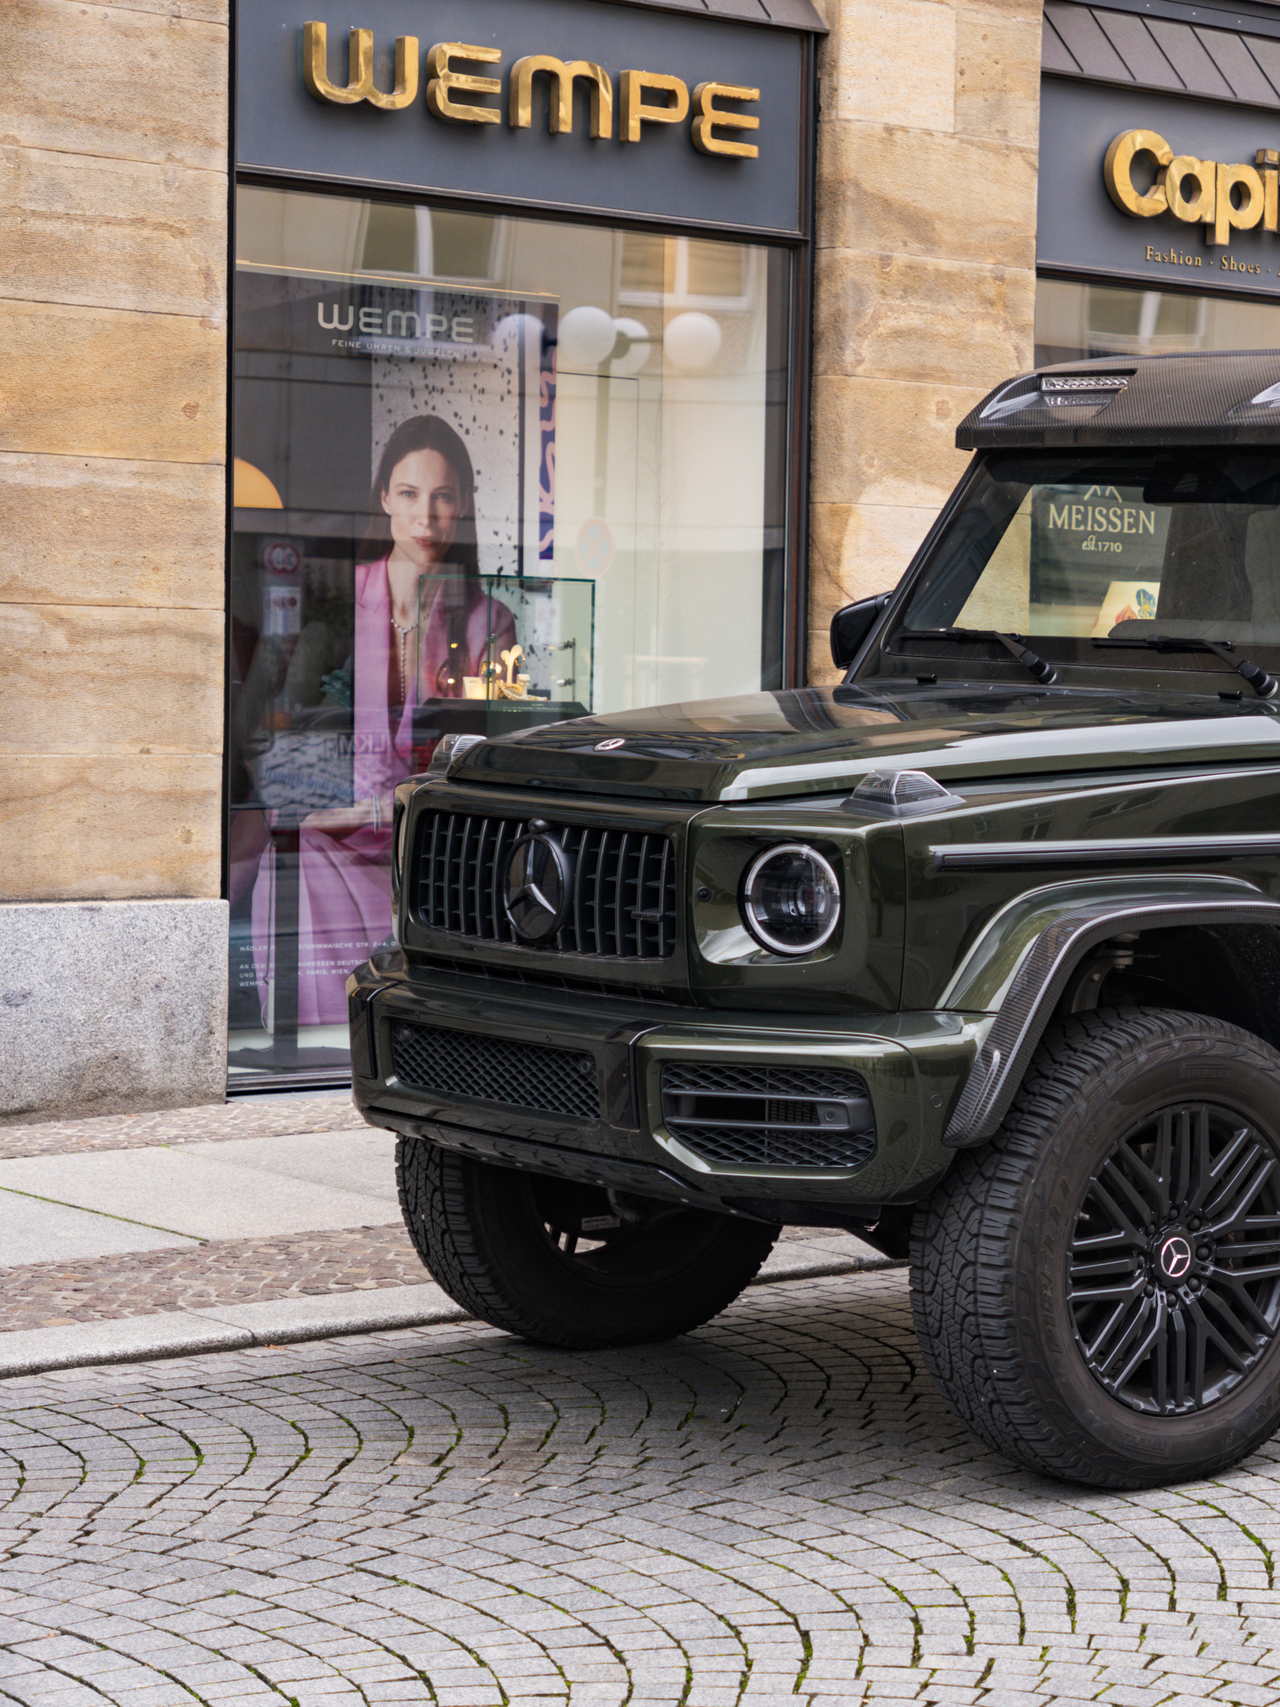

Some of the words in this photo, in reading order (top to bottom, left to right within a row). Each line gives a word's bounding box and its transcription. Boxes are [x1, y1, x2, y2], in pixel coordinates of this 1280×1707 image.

[303, 20, 760, 160] WEMPE
[1145, 245, 1203, 267] Fashion
[1221, 255, 1261, 274] Shoes
[317, 302, 474, 343] WEMPE
[332, 339, 361, 349] FEINE
[366, 343, 400, 352] UHREN
[414, 347, 460, 358] JUWELEN
[1048, 503, 1155, 535] MEISSEN
[1179, 1063, 1232, 1080] PIRELLI
